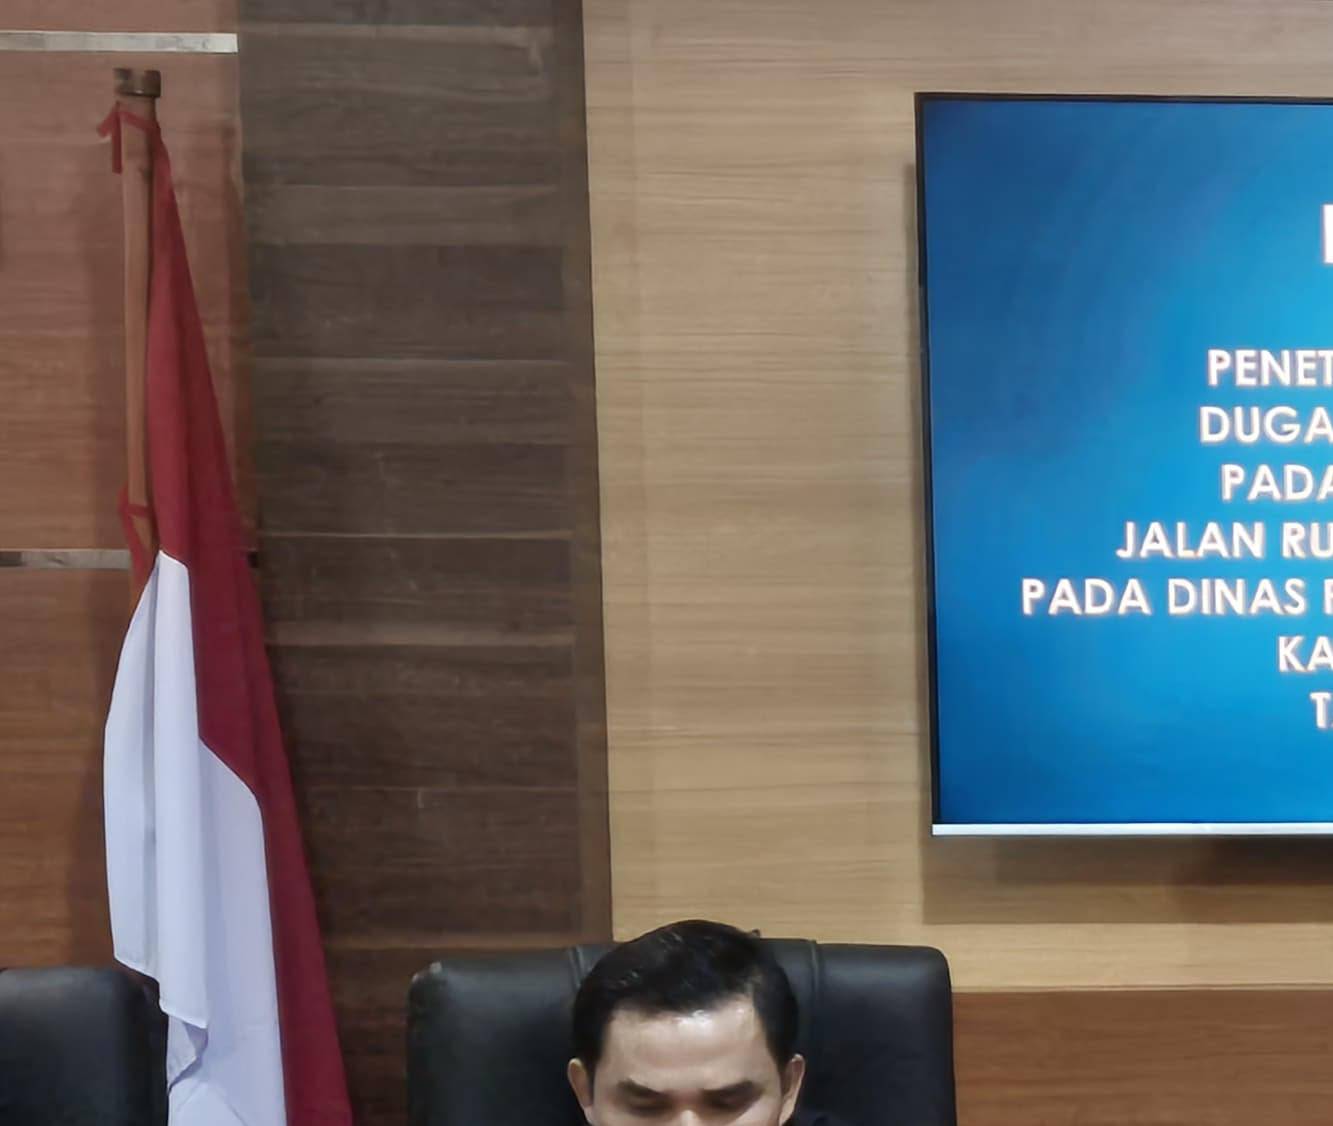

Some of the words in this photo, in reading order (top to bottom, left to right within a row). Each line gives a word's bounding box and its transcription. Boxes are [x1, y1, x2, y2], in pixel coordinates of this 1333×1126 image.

[1115, 520, 1266, 560] JALAN
[1021, 577, 1153, 616] PADA
[1167, 576, 1308, 617] DINAS
